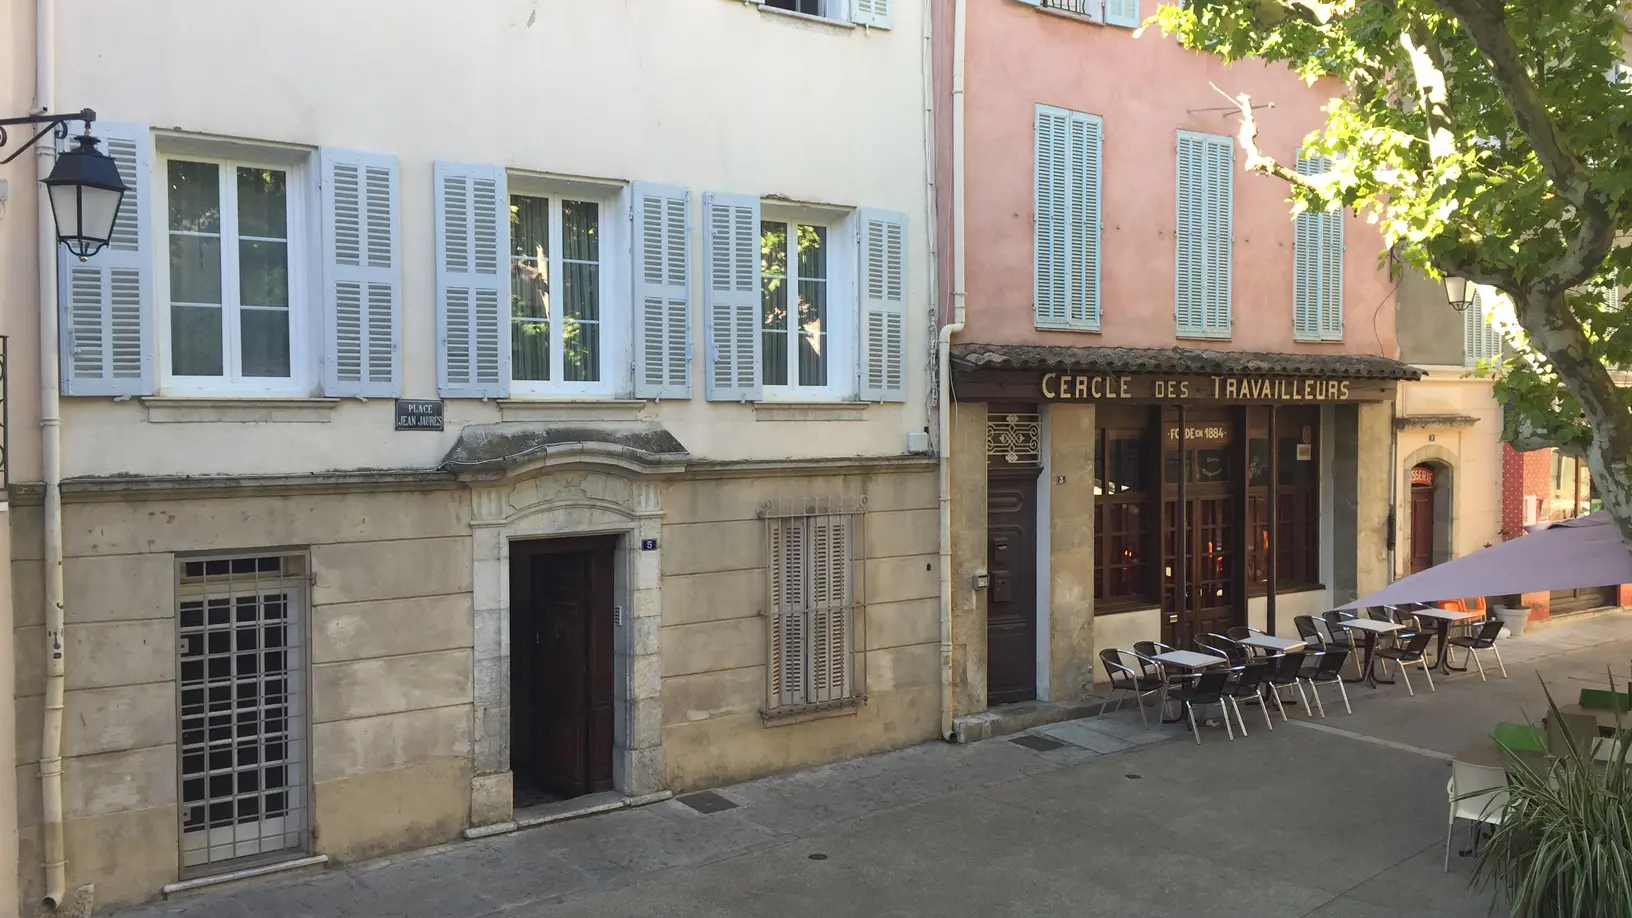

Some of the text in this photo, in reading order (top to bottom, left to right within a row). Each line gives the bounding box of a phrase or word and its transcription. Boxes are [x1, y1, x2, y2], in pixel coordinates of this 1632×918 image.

[1042, 372, 1350, 400] CERCLE DES TRAVAILLEURS
[408, 404, 433, 414] PLACE
[398, 415, 416, 426] JEAN
[1170, 428, 1195, 440] FODE
[1204, 427, 1224, 439] 1884
[646, 540, 653, 549] 5
